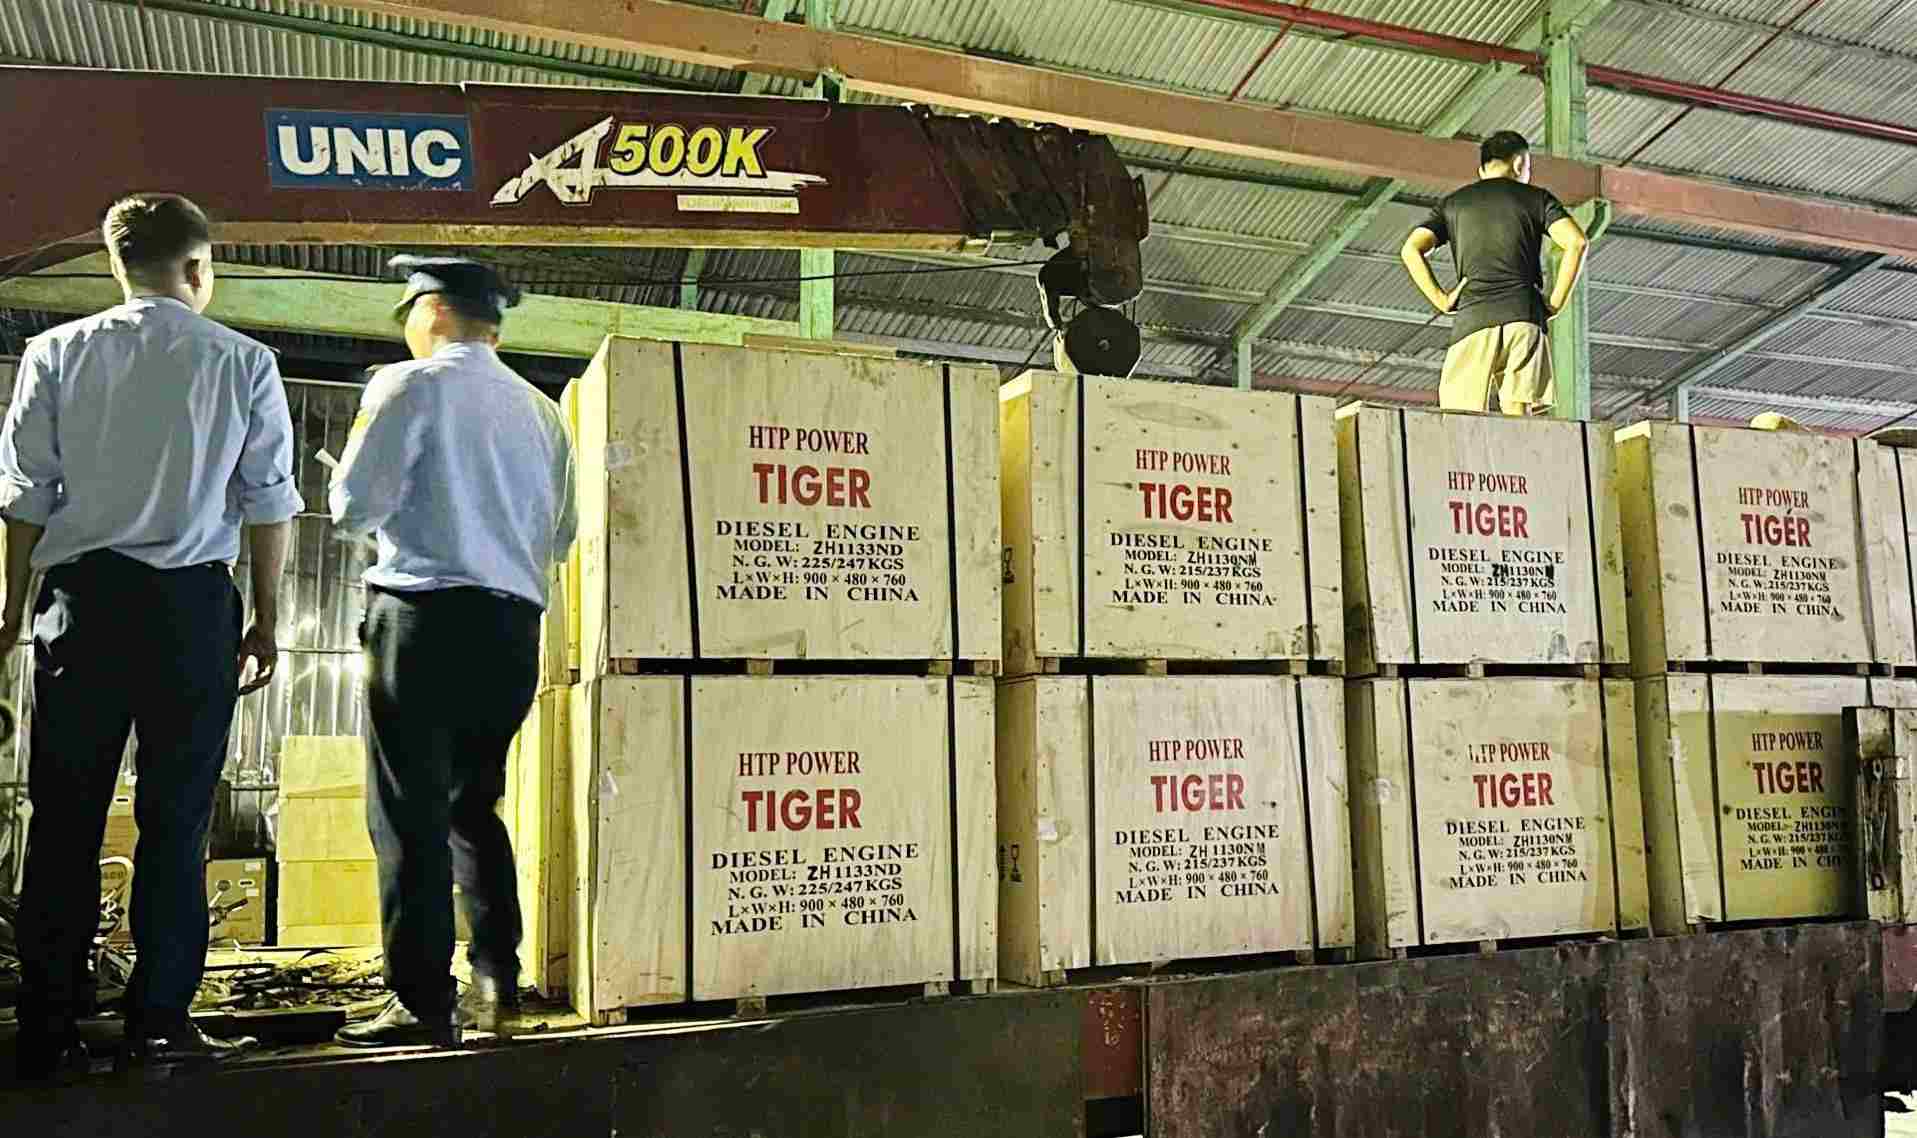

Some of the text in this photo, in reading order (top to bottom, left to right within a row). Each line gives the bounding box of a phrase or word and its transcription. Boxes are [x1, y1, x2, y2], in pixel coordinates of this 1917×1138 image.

[278, 125, 461, 178] UNIC
[750, 426, 869, 455] HTP POWER
[1136, 449, 1231, 476] HTP POWER
[753, 464, 871, 508] TIGER
[1449, 472, 1527, 494] HTP POWER
[1139, 483, 1232, 523] TIGER
[1739, 488, 1809, 508] HTP POWER
[1449, 502, 1528, 538] TIGER
[717, 521, 920, 541] DIESEL ENGINE
[1741, 514, 1811, 547] TIGER
[734, 540, 903, 556] MODEL: ZH1133ND
[1111, 533, 1272, 551] DIESEL ENGINE
[1125, 550, 1176, 561] MODEL:
[1429, 548, 1564, 564] DIESEL ENGINE
[1718, 553, 1837, 569] DIESEL ENGINE
[804, 573, 827, 584] 900
[845, 574, 867, 585] 480
[884, 574, 905, 586] 760
[1181, 580, 1199, 589] 900
[1245, 582, 1262, 591] 760
[717, 586, 919, 601] MADE IN CHINA
[1113, 591, 1273, 606] MADE IN CHINA
[1433, 601, 1566, 614] MADE IN CHINA
[1721, 602, 1840, 616] MADE IN CHINA
[1150, 739, 1244, 761] HTP POWER
[1780, 731, 1823, 750] POWER
[1501, 742, 1550, 762] POWER
[739, 752, 860, 776] HTP POWER
[1753, 762, 1824, 793] TIGER
[1151, 774, 1245, 812] TIGER
[1473, 773, 1554, 808] TIGER
[742, 789, 862, 832] TIGER
[1116, 825, 1279, 845] DIESEL ENGINE
[1447, 817, 1585, 835] DIESEL ENGINE
[712, 844, 919, 869] DIESEL ENGINE
[1130, 845, 1182, 858] MODEL:
[730, 864, 901, 883] MODEL: ZH1133ND
[1186, 873, 1205, 883] 900
[1251, 870, 1268, 880] 760
[1451, 871, 1586, 888] MADE IN CHINA
[800, 899, 823, 911] 900
[841, 896, 864, 908] 480
[882, 894, 903, 906] 760
[1117, 883, 1278, 903] MADE IN CHINA
[712, 908, 918, 935] MADE IN CHINA
